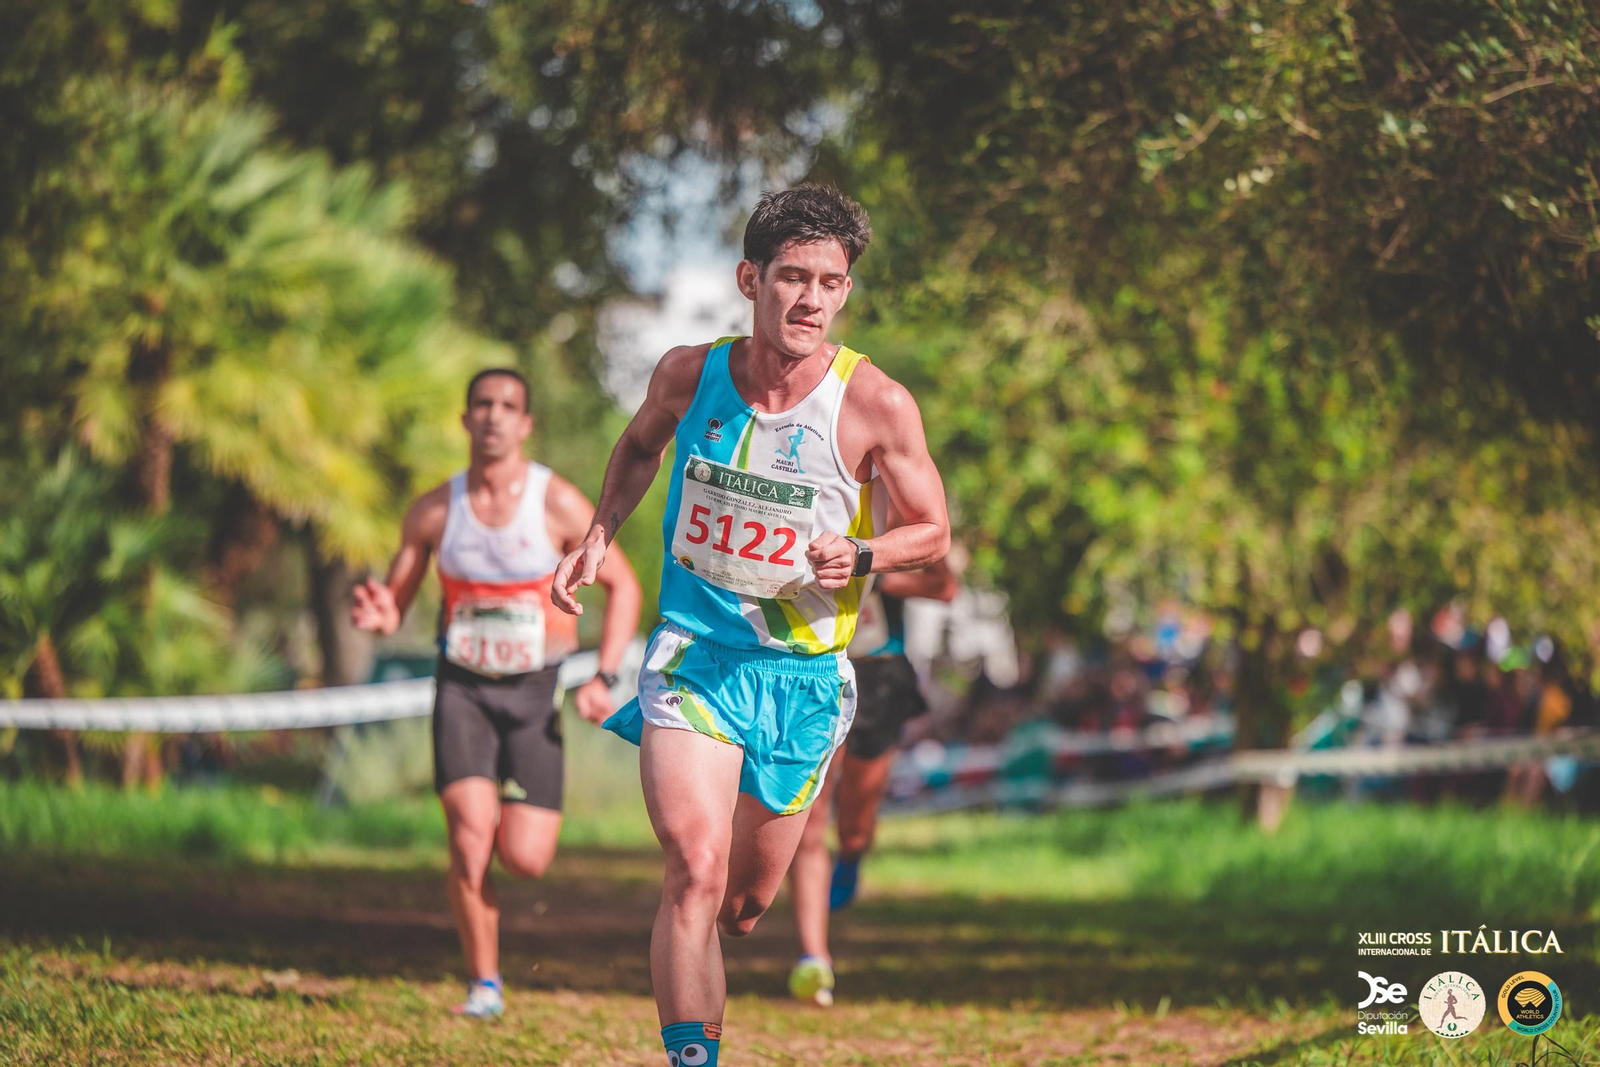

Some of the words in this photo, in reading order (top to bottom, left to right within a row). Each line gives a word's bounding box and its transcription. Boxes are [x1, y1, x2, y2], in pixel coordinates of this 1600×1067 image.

[771, 464, 798, 474] CASTILLO
[776, 458, 794, 467] MAURI
[719, 472, 779, 499] ITÁLICA
[703, 488, 726, 500] GARRIDO
[757, 504, 792, 515] ALEJANDRO
[685, 503, 797, 567] 5122
[457, 635, 533, 671] 5105
